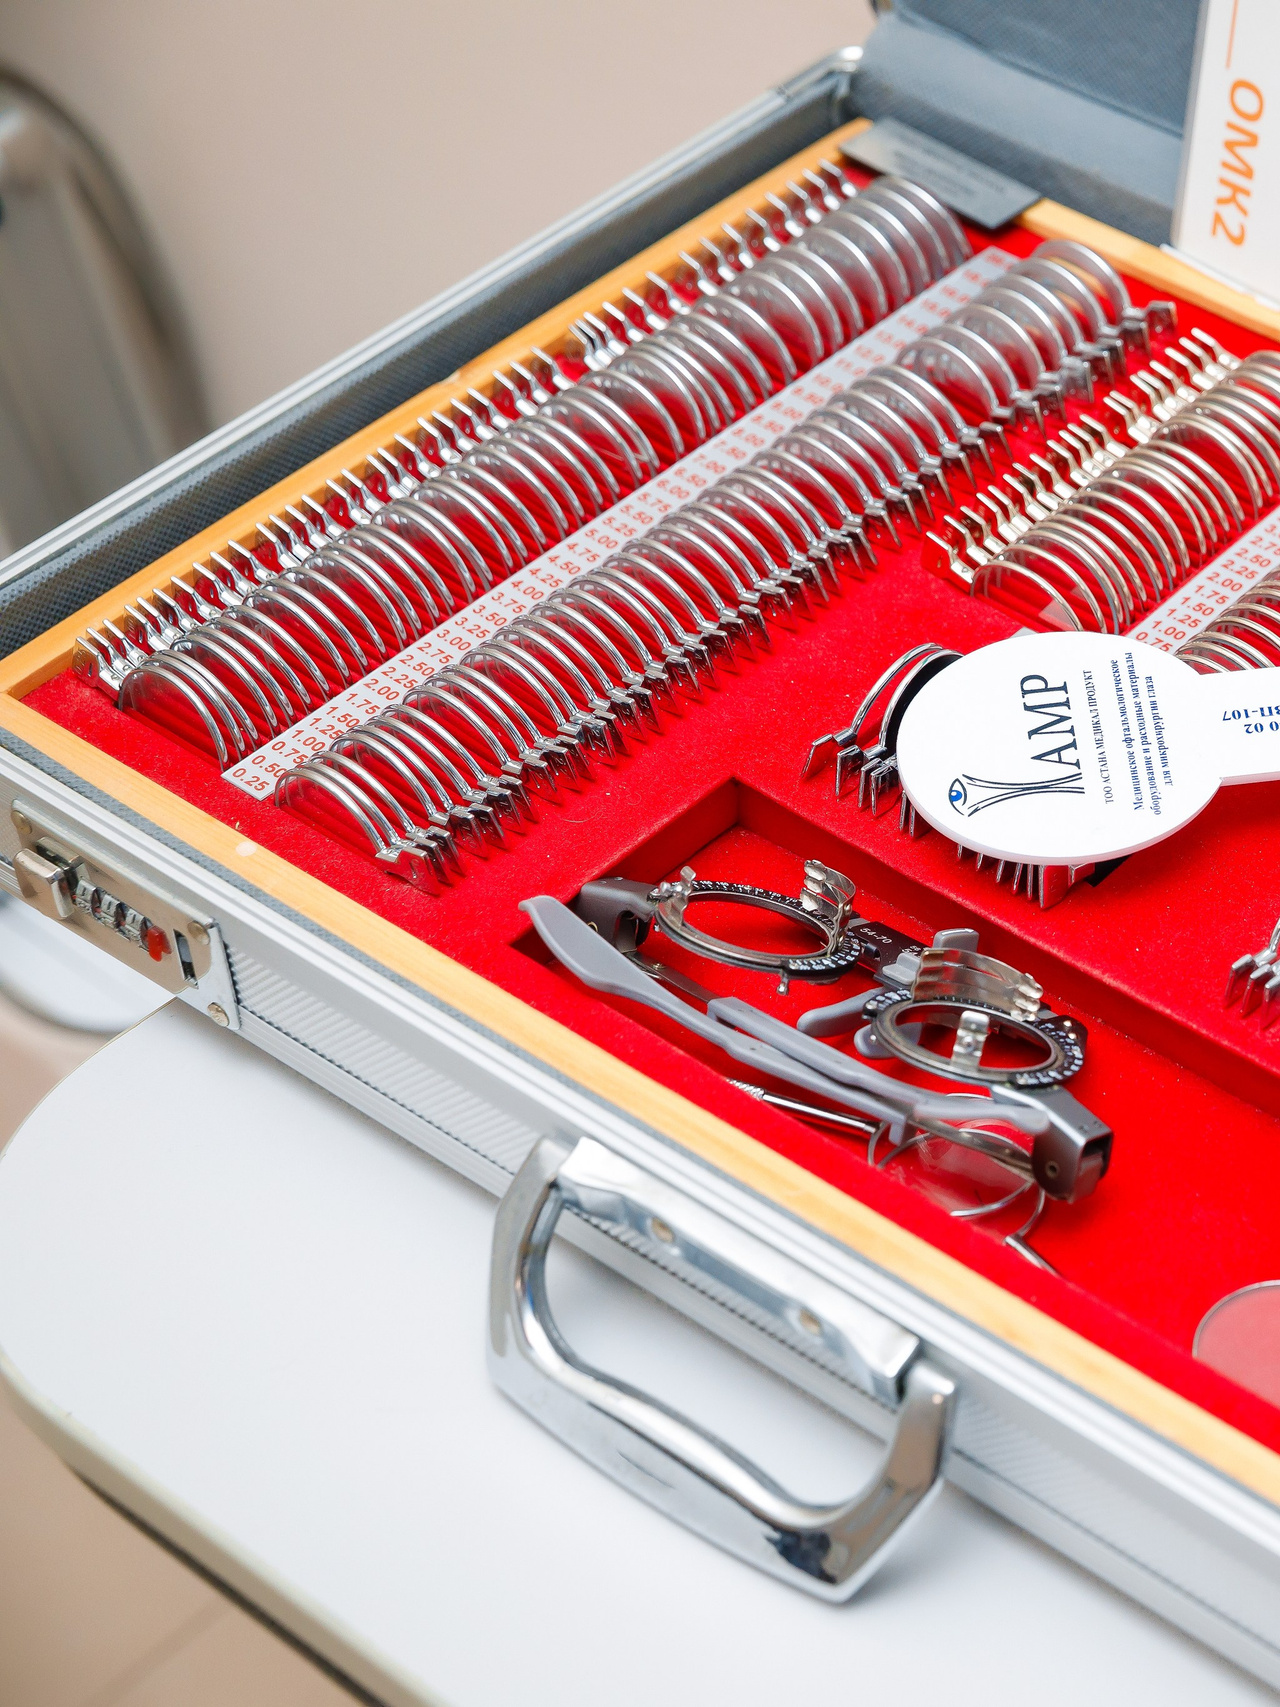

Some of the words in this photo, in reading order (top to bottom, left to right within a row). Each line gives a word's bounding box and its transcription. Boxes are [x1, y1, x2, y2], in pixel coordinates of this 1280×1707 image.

[1210, 78, 1264, 246] ОМК2
[1236, 548, 1272, 568] 2.50
[1222, 560, 1258, 579] 2.25
[1206, 572, 1242, 592] 2.00
[1195, 584, 1228, 604] 1.75
[1181, 596, 1214, 616] 1.50
[1167, 609, 1201, 628] 1.25
[436, 630, 470, 651] 3.00
[1152, 621, 1186, 640] 1.00
[1136, 632, 1173, 653] 0.75
[417, 643, 453, 664] 2.75
[399, 655, 435, 676] 2.50
[1123, 651, 1140, 699] материалы
[381, 667, 418, 688] 2.25
[1081, 669, 1098, 707] ПРОДУКТ
[1143, 674, 1156, 698] глаза
[364, 679, 399, 701] 2.00
[345, 693, 381, 715] 1.75
[1109, 658, 1135, 749] офтальмологическое
[326, 706, 361, 728] 1.50
[1132, 699, 1152, 746] расходные
[1242, 721, 1264, 734] 02
[309, 717, 343, 739] 1.25
[1088, 707, 1105, 750] МЕДИКАЛ
[1148, 699, 1169, 768] микрохирургии
[292, 729, 326, 752] 1.00
[1141, 746, 1151, 754] и
[1096, 749, 1111, 784] АСТАНА
[232, 768, 269, 791] 0.25
[1125, 749, 1144, 811] Медицинское
[1142, 754, 1162, 816] оборудование
[1161, 769, 1173, 786] для
[1102, 784, 1114, 804] ТОО
[860, 927, 892, 944] 54-70
